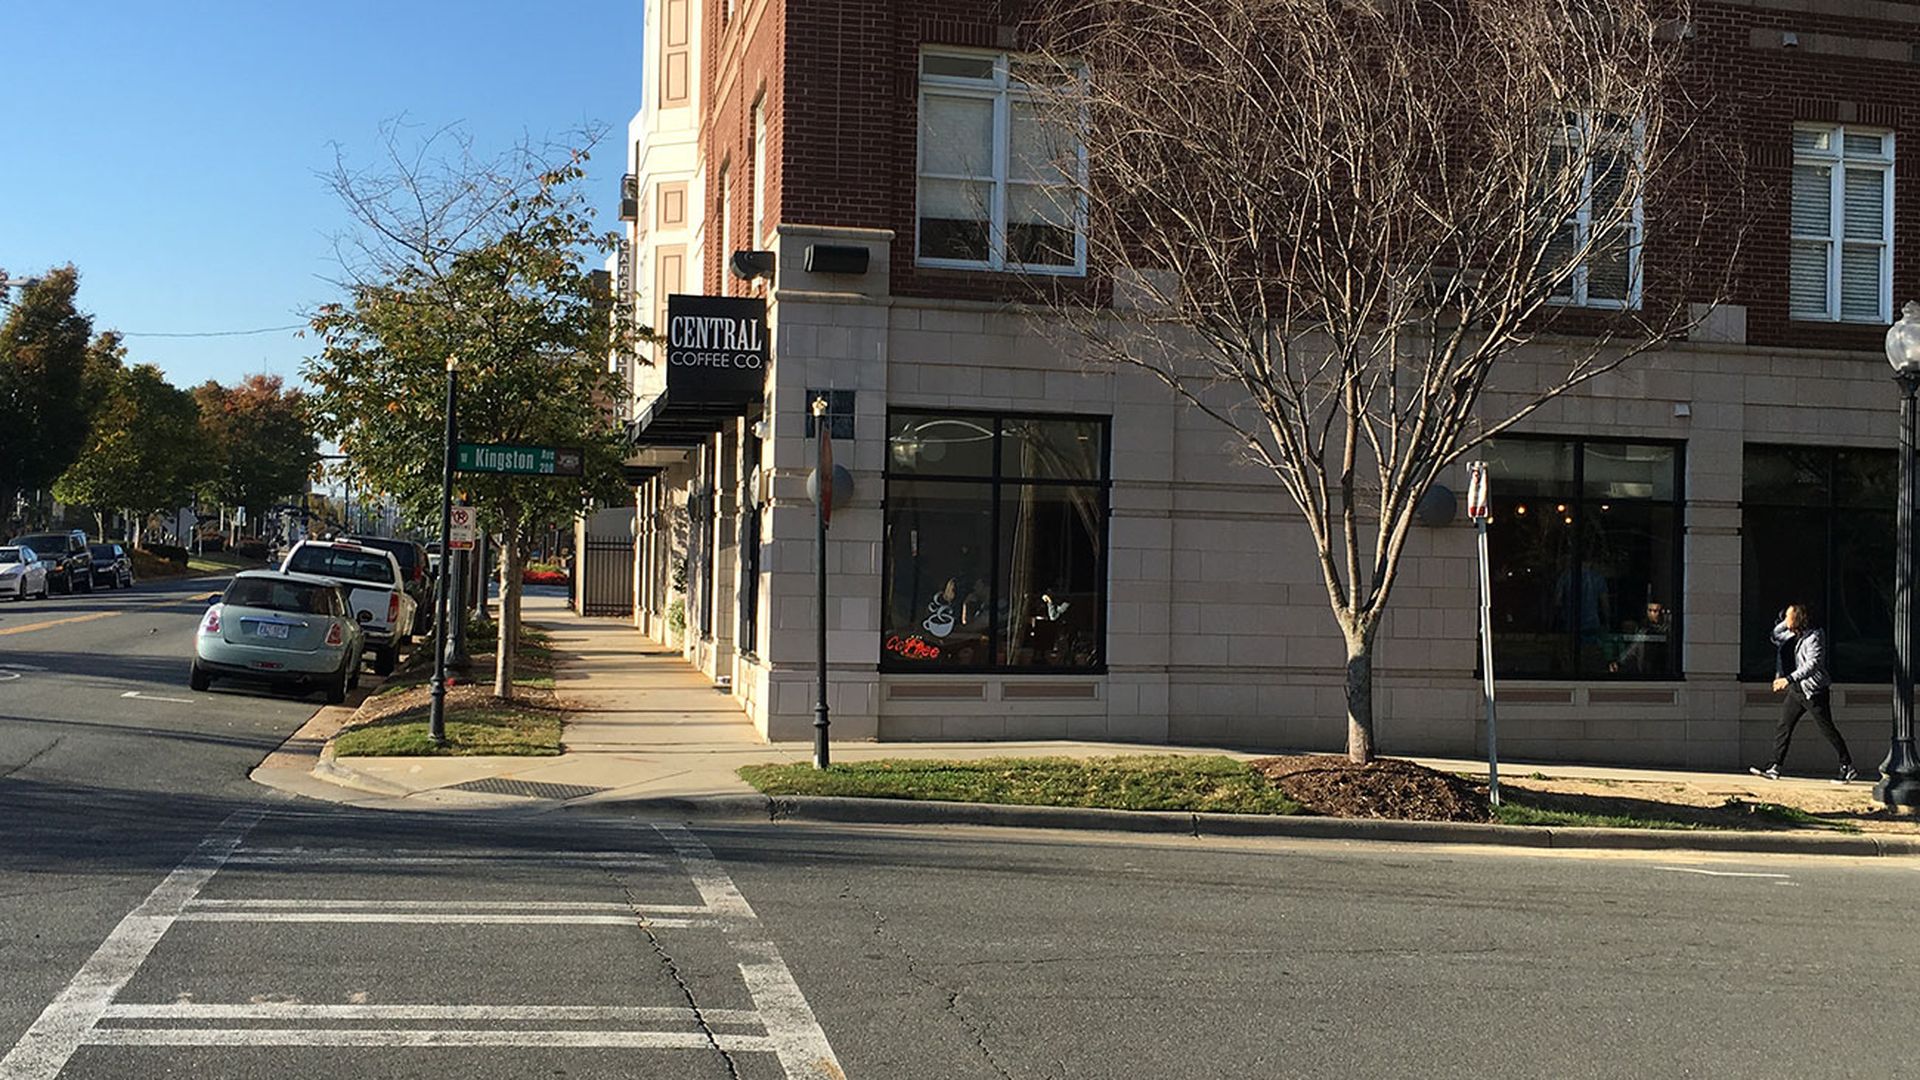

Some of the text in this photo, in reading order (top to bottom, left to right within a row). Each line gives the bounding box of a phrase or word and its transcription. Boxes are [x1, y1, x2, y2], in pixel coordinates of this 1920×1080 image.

[671, 316, 762, 351] CENTRAL
[670, 351, 762, 369] COFFEE CO.
[475, 447, 534, 471] Kingston
[541, 449, 555, 460] Ave
[539, 462, 555, 474] 200
